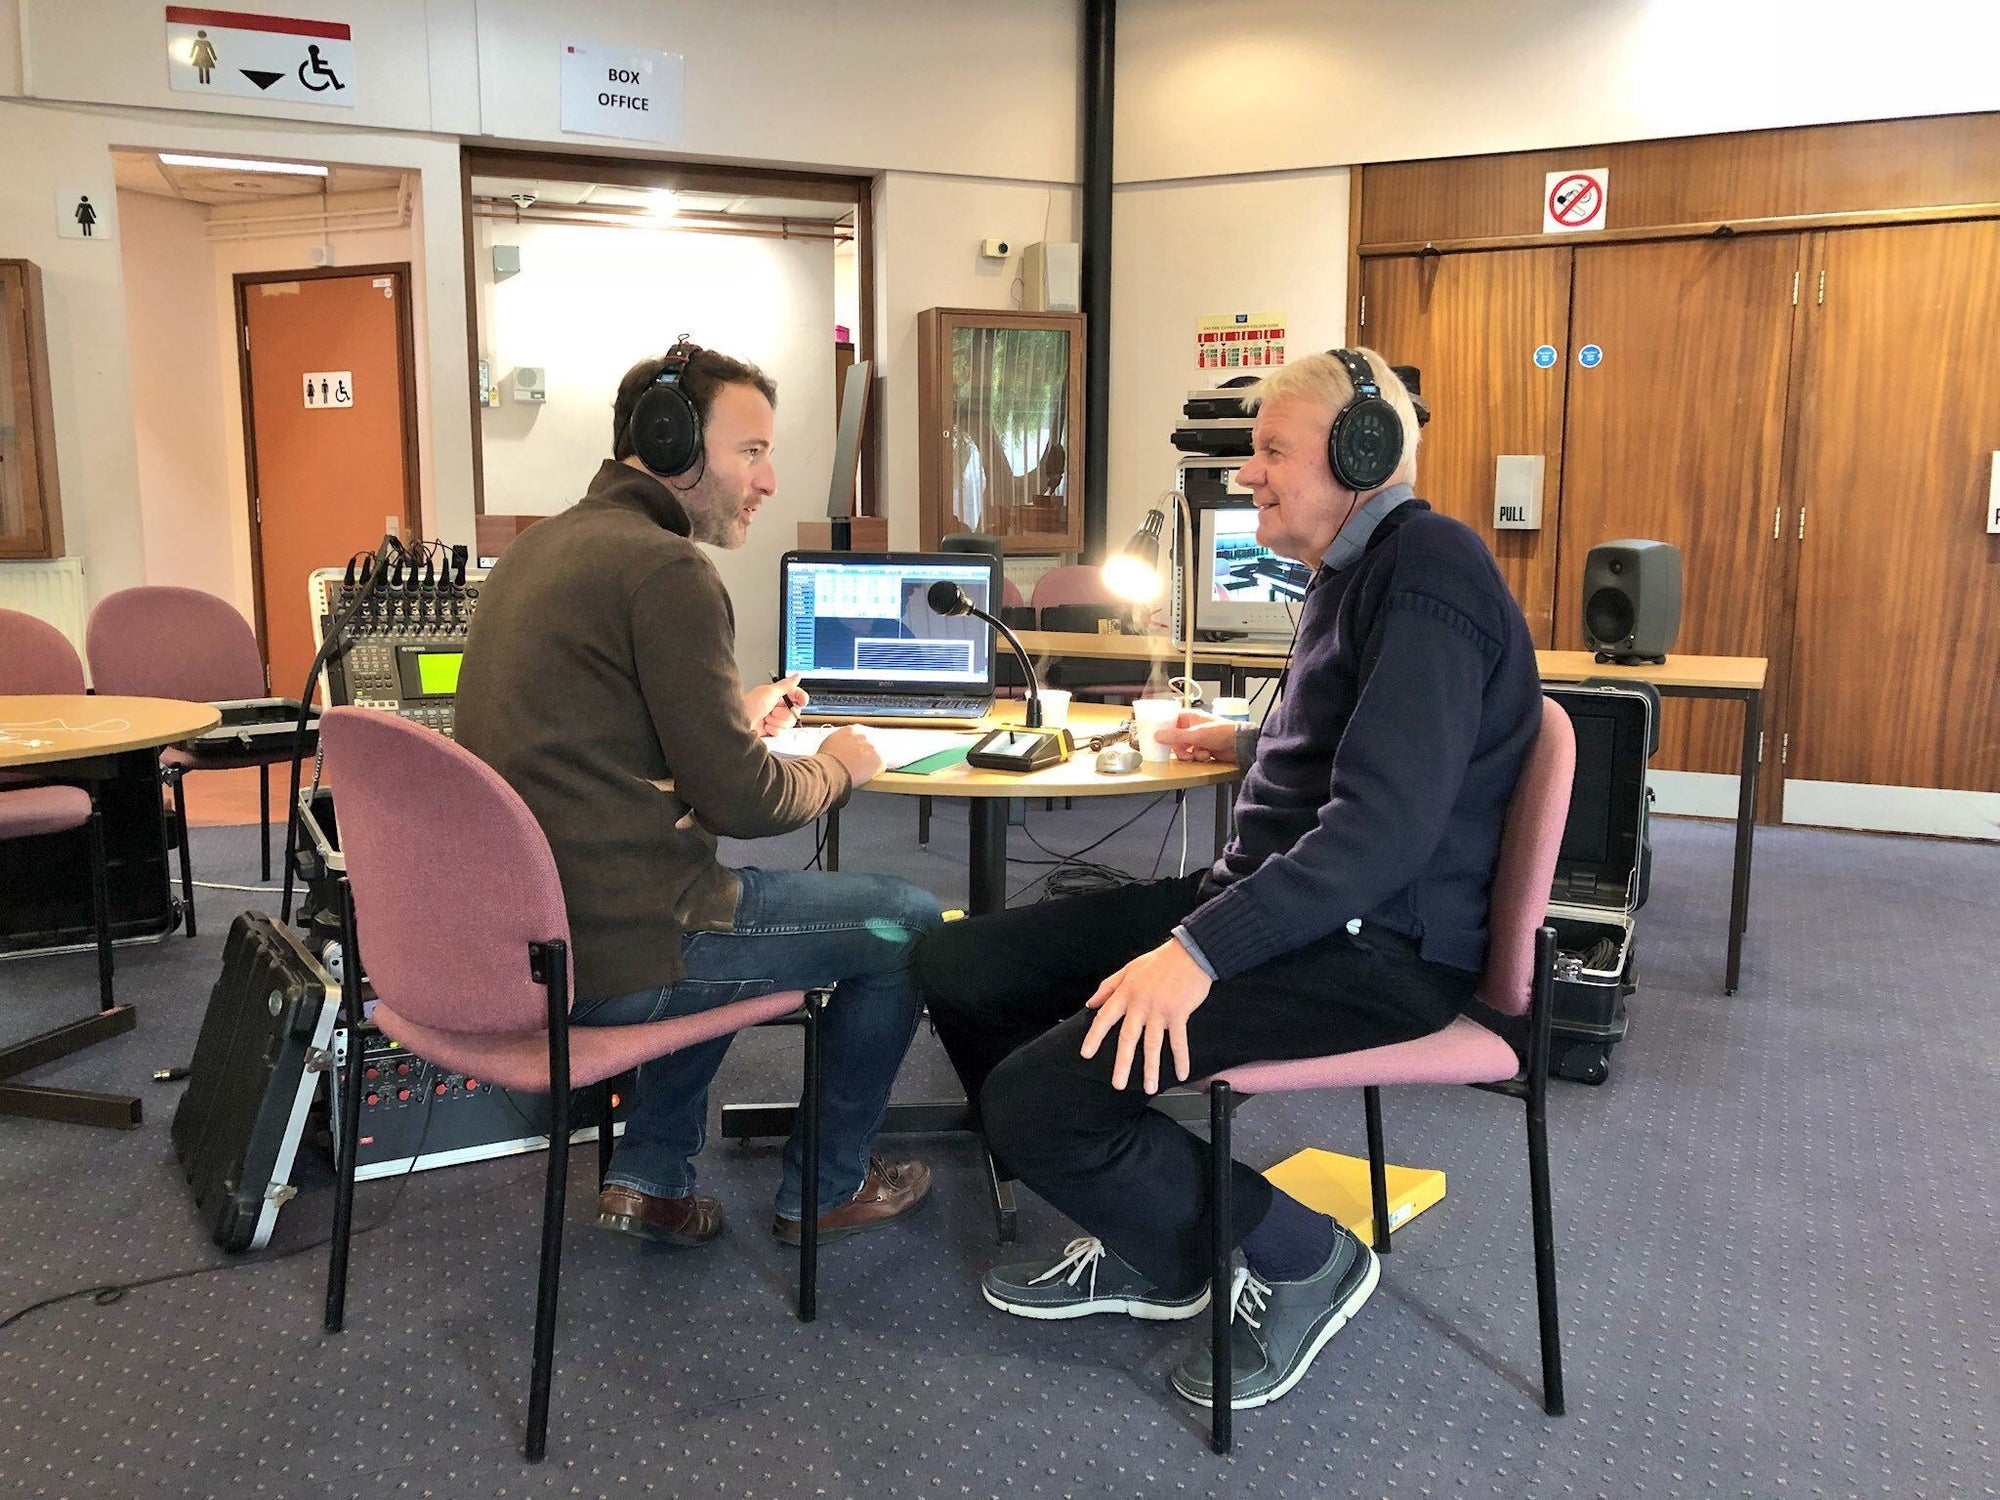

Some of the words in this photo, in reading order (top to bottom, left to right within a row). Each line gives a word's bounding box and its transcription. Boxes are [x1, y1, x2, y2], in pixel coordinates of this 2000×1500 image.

[608, 68, 640, 85] BOX
[597, 92, 649, 111] OFFICE
[1499, 506, 1525, 521] PULL
